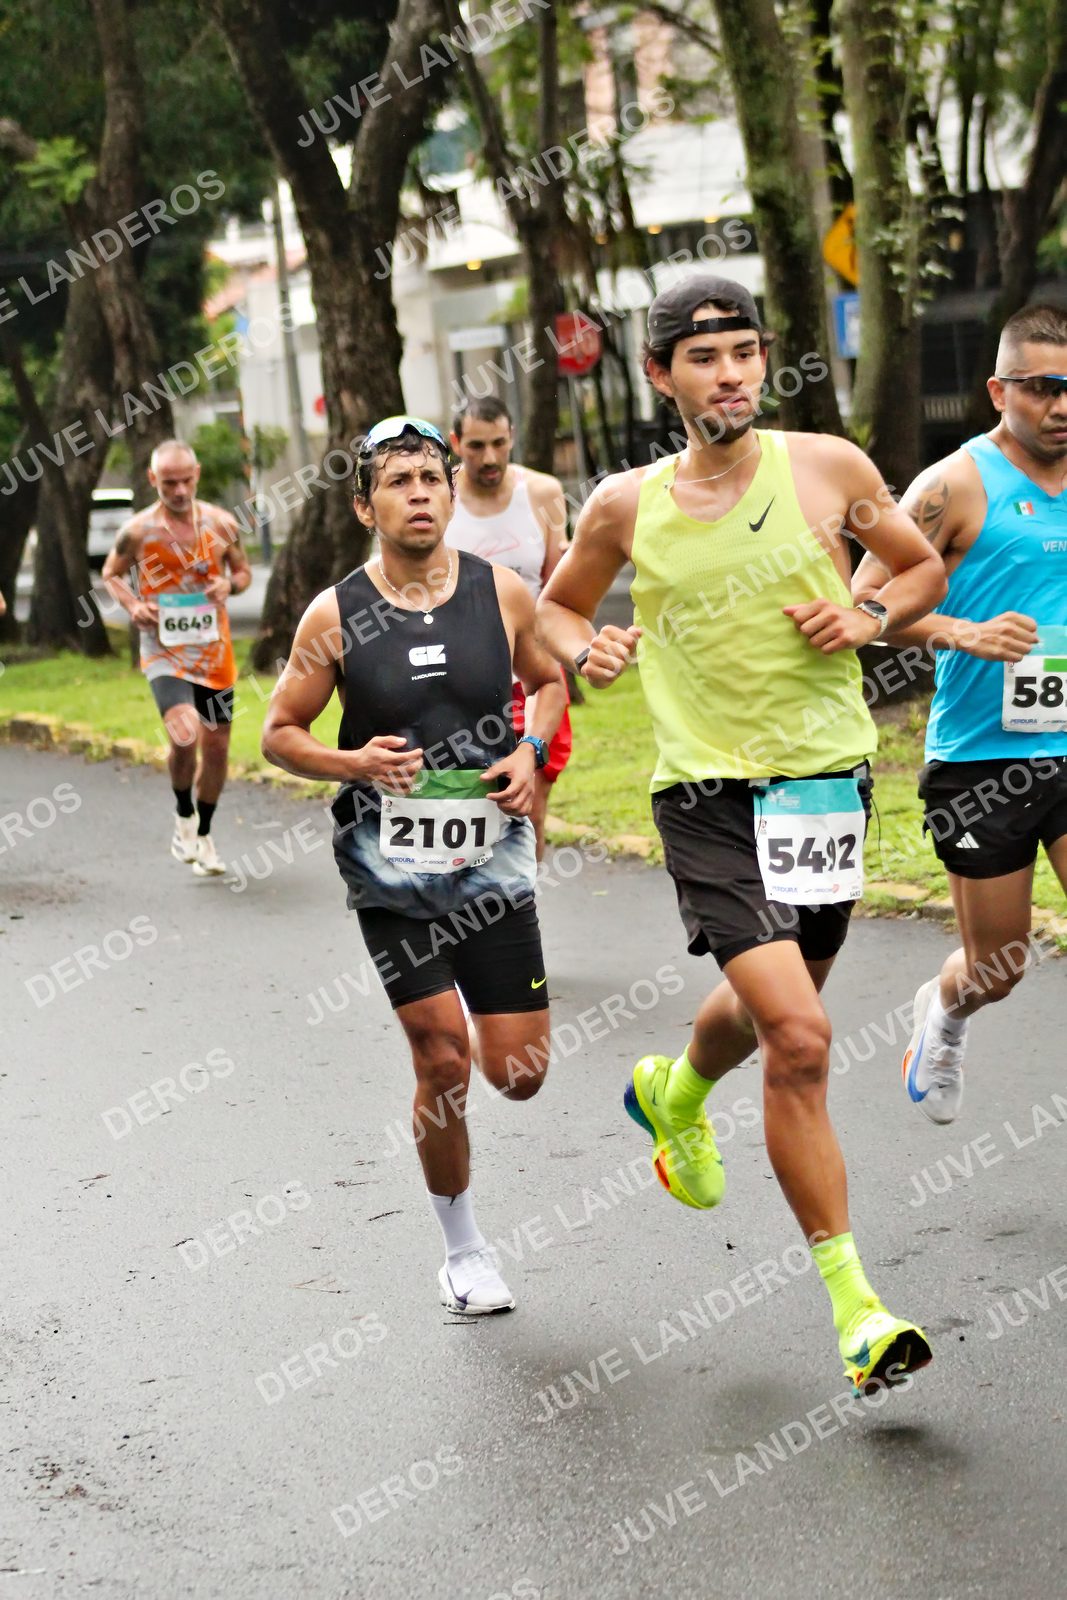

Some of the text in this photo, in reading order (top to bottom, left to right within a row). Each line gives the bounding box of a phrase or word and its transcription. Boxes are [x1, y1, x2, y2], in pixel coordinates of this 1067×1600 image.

[165, 615, 212, 632] 6649
[1011, 675, 1067, 708] 58
[389, 816, 487, 849] 2101
[767, 833, 857, 875] 5492
